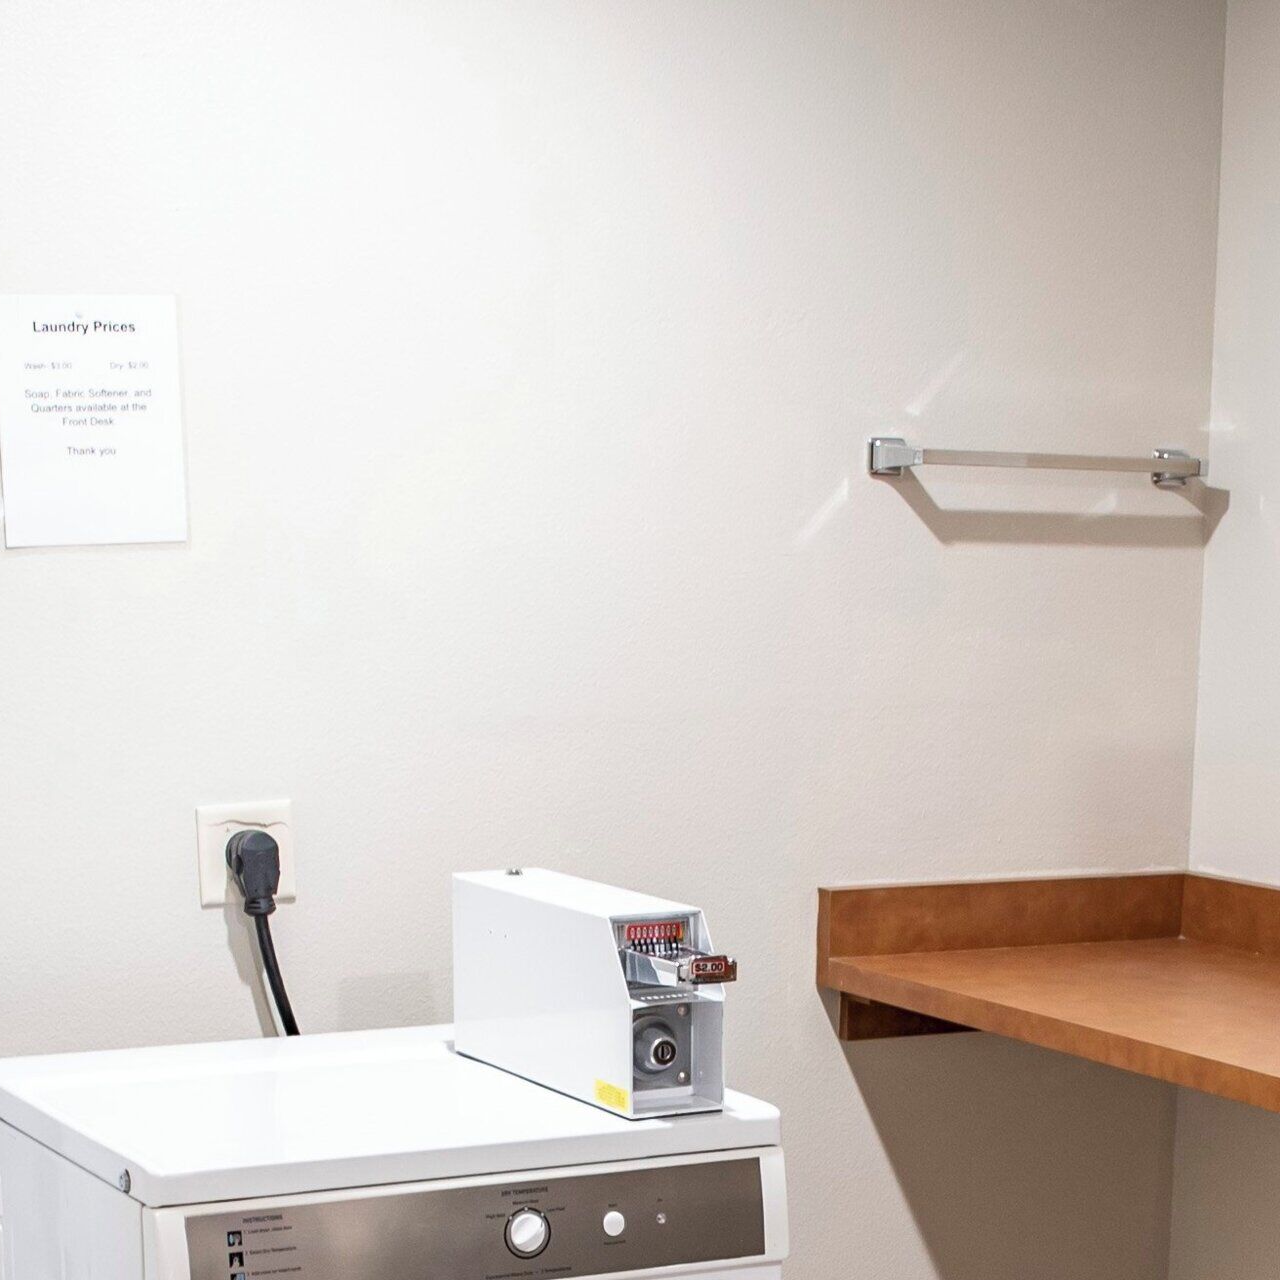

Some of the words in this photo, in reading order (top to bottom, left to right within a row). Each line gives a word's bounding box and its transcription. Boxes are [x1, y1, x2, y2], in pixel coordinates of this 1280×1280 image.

[32, 320, 89, 335] Laundry
[93, 320, 136, 333] Prices
[55, 388, 84, 398] Fabric
[134, 388, 152, 398] and
[30, 403, 73, 413] Quarters
[76, 403, 118, 413] available
[120, 403, 129, 412] at
[132, 402, 148, 412] the
[62, 417, 88, 427] Front
[67, 446, 96, 456] Thank
[99, 448, 117, 457] you
[694, 962, 723, 972] $2.00
